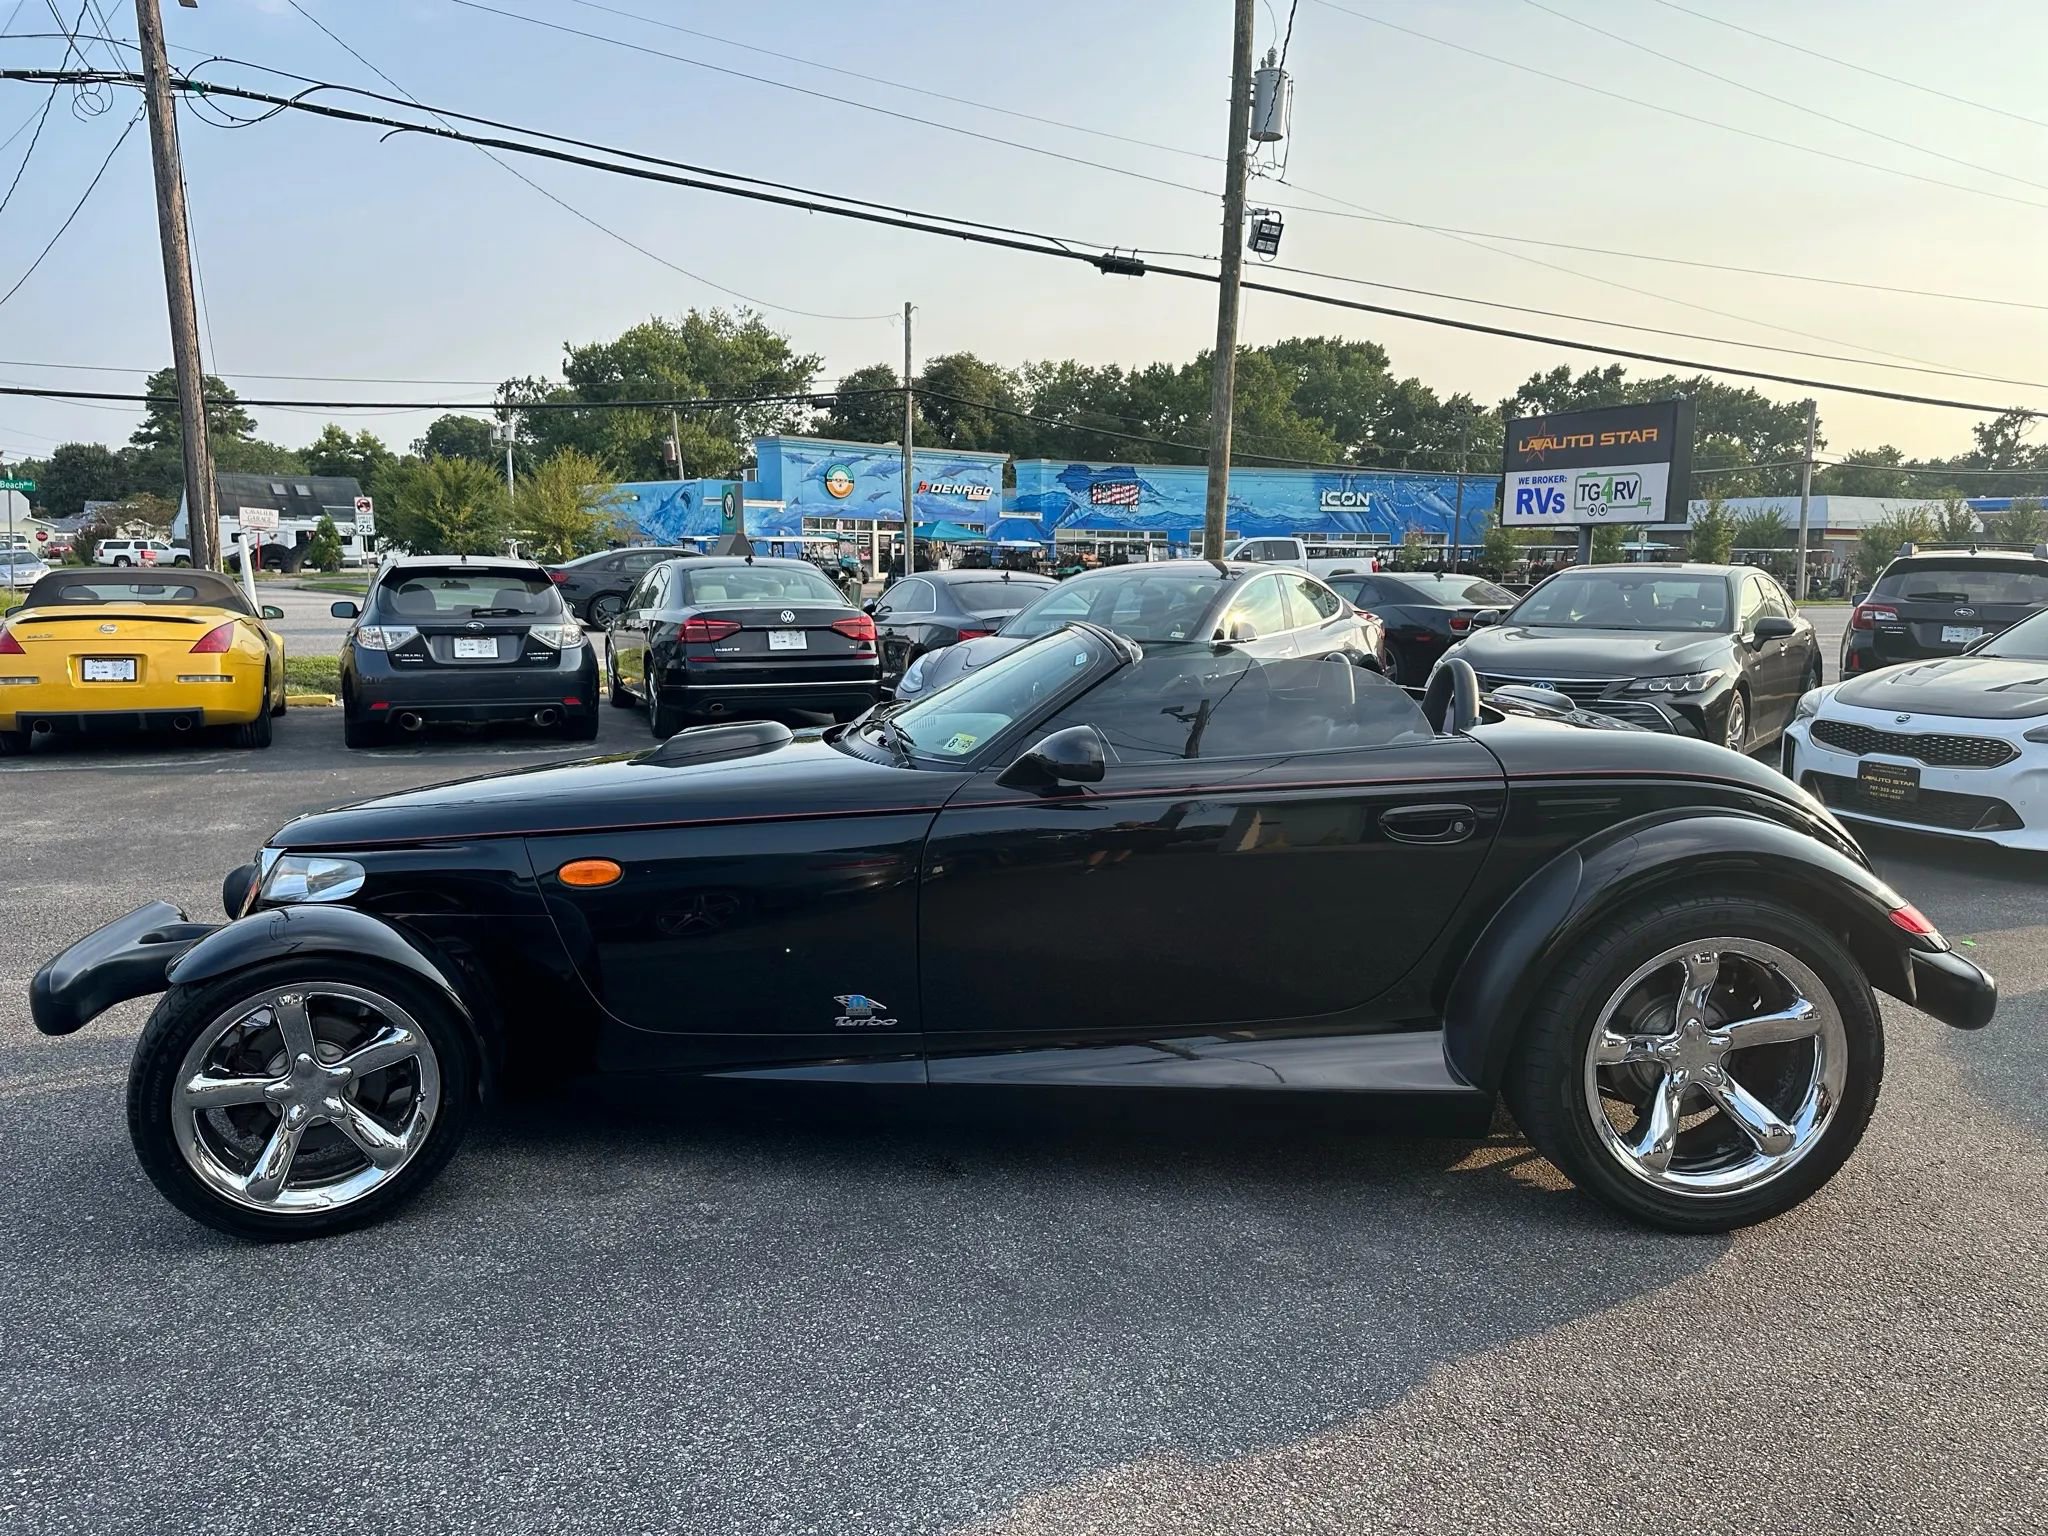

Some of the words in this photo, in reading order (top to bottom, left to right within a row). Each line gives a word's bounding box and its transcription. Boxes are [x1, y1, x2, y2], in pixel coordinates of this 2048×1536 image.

[1600, 428, 1658, 446] STAR
[0, 480, 24, 489] Beach
[1518, 476, 1531, 485] WE
[1532, 474, 1568, 485] BROKER:
[930, 483, 994, 496] DENAGO
[1579, 477, 1639, 503] TG4RV
[1321, 491, 1371, 506] ICON
[1516, 487, 1566, 515] RVs
[359, 524, 373, 533] 25
[834, 1015, 898, 1027] Turbo
